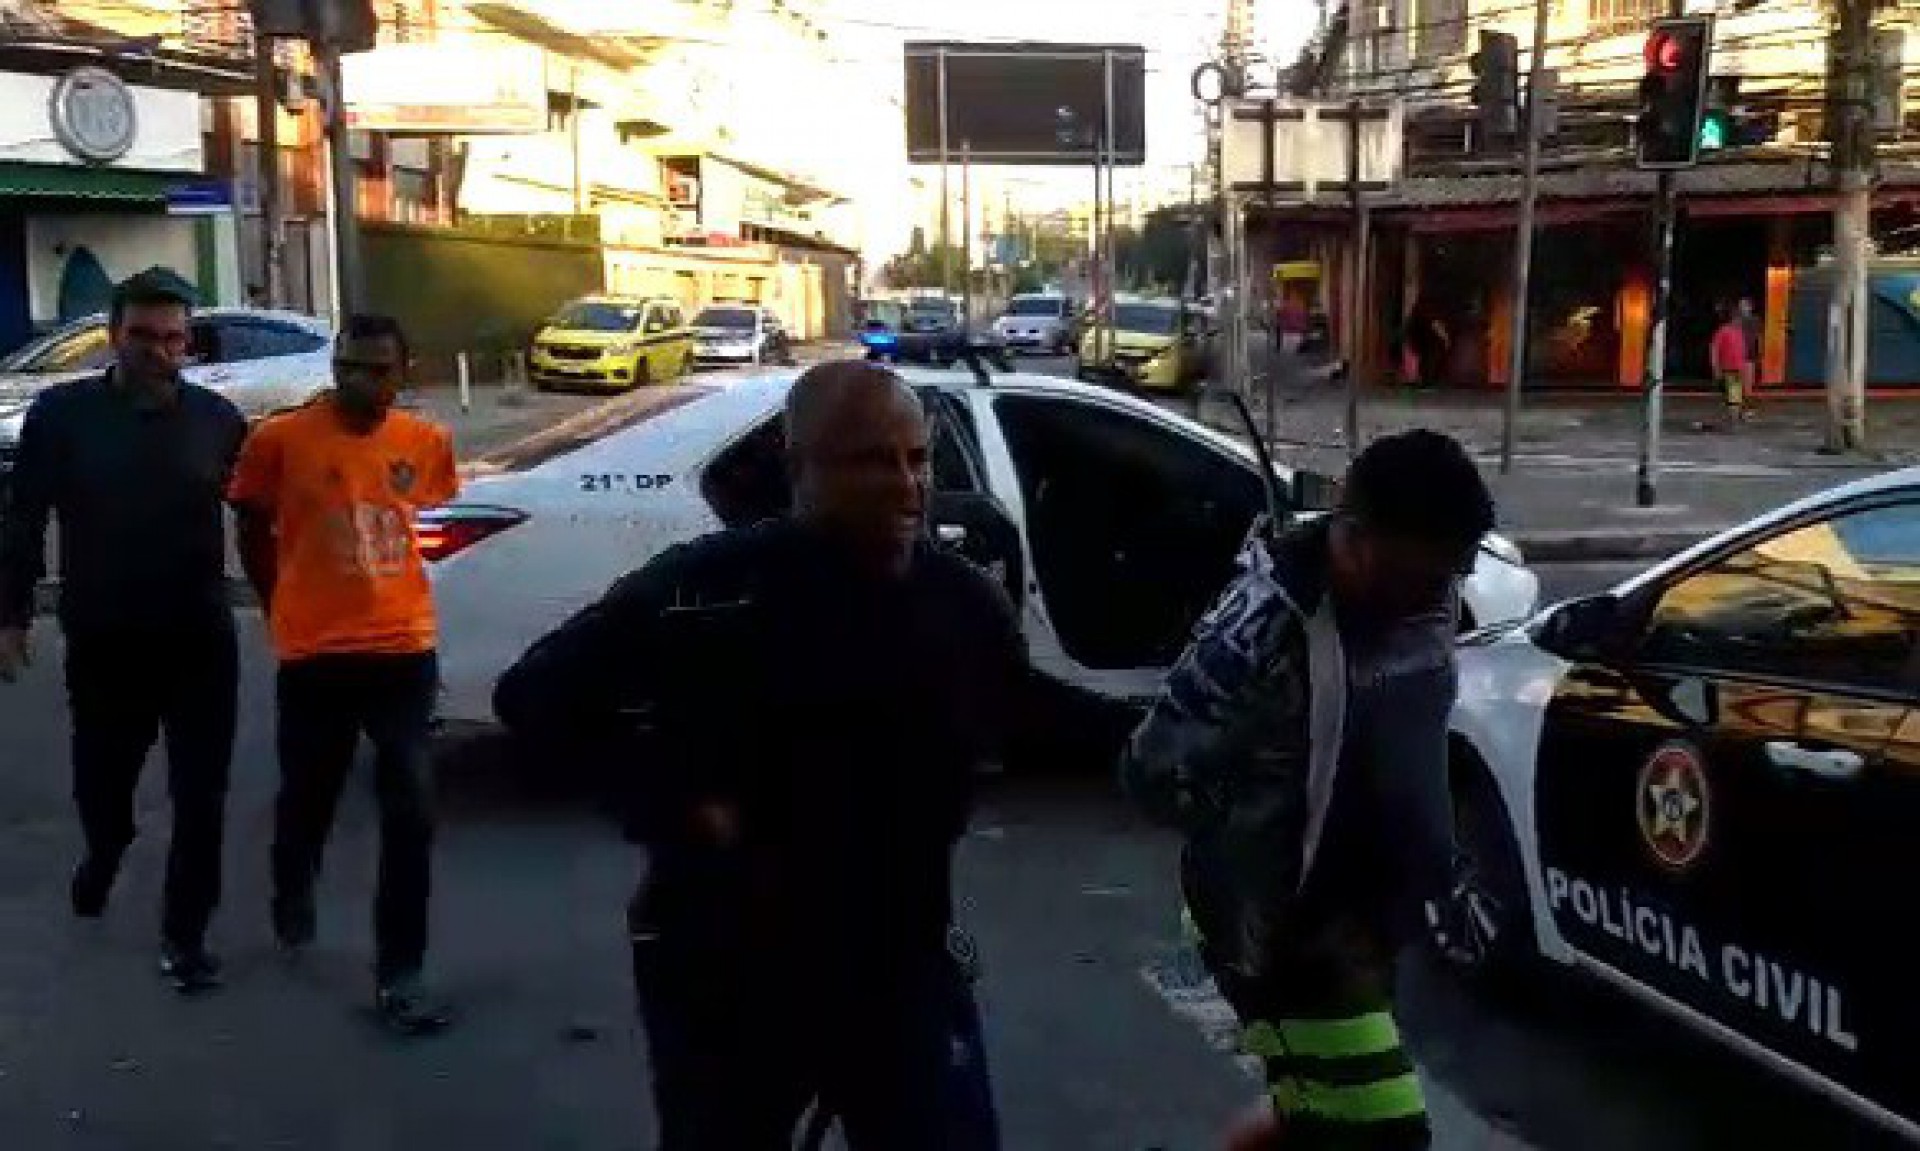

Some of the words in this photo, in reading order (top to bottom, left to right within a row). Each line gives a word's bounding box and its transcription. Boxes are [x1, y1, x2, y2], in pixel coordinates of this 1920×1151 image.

[635, 474, 674, 490] DP
[1547, 866, 1710, 980] POLÍCIA
[1722, 945, 1859, 1051] CIVIL
